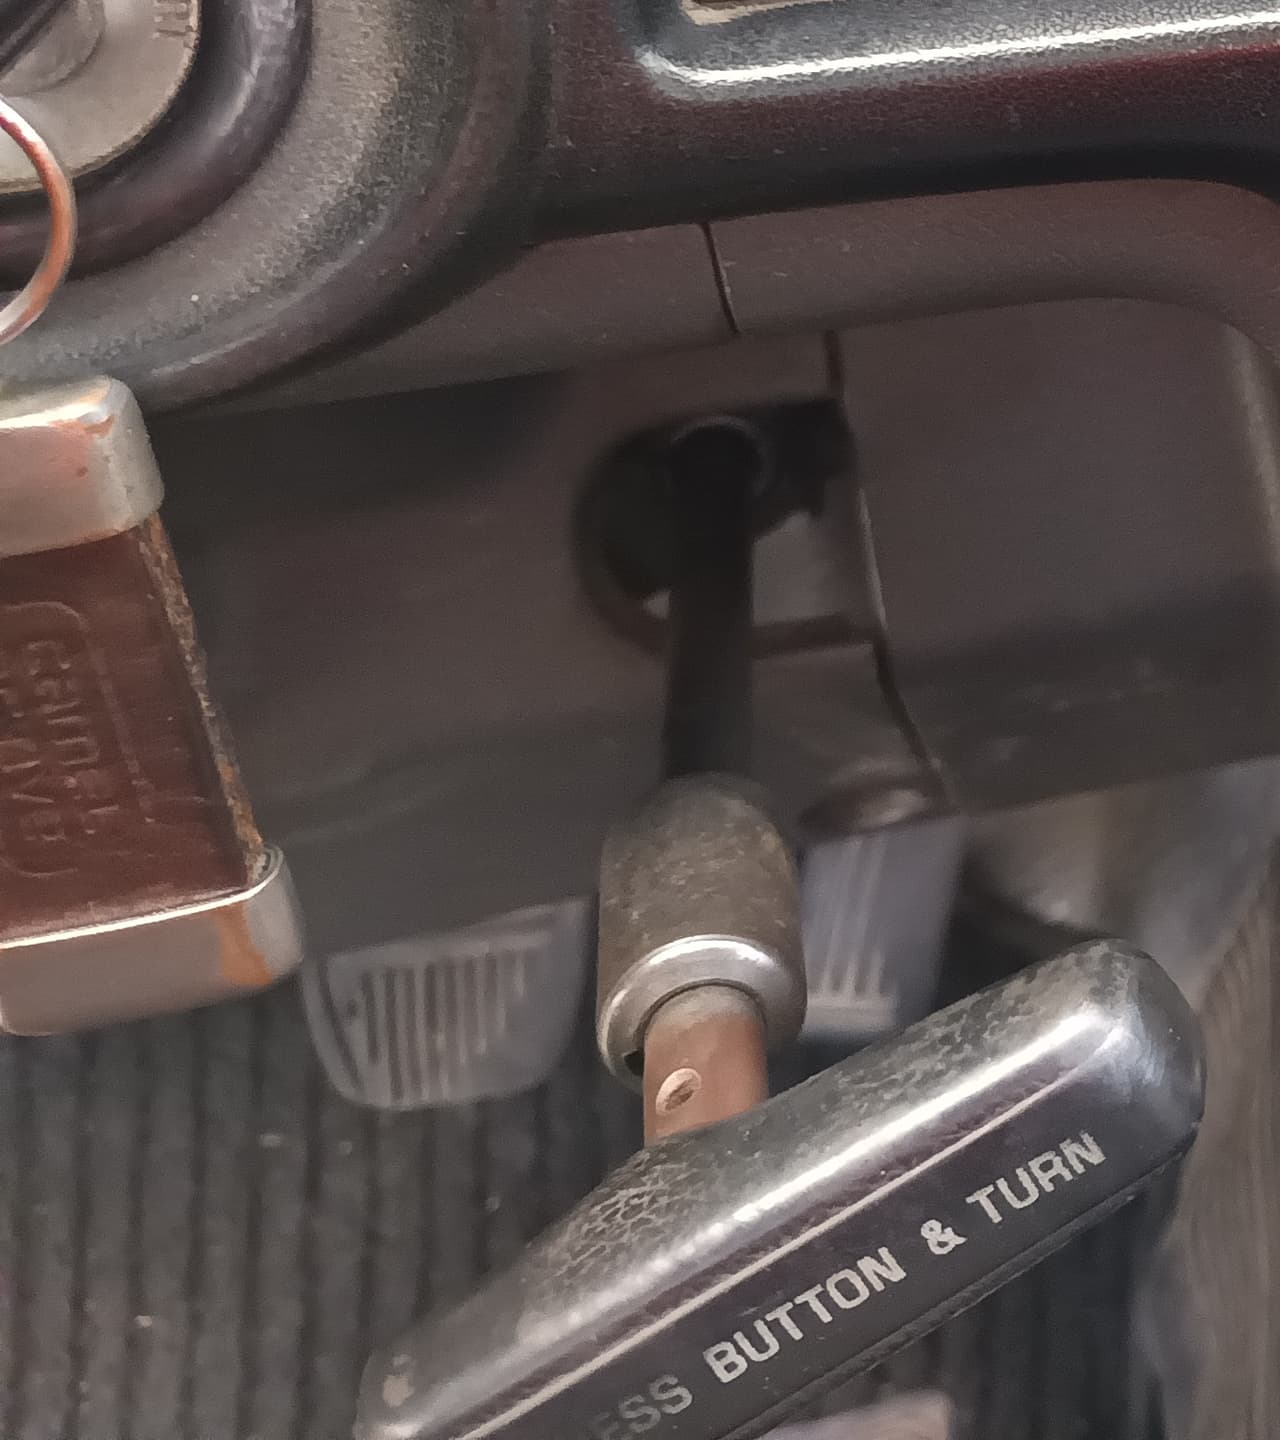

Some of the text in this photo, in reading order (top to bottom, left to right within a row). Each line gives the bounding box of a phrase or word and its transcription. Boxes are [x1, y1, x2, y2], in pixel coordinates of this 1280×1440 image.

[703, 1246, 907, 1385] BUTTON
[919, 1218, 967, 1256] &
[965, 1130, 1107, 1226] TURN
